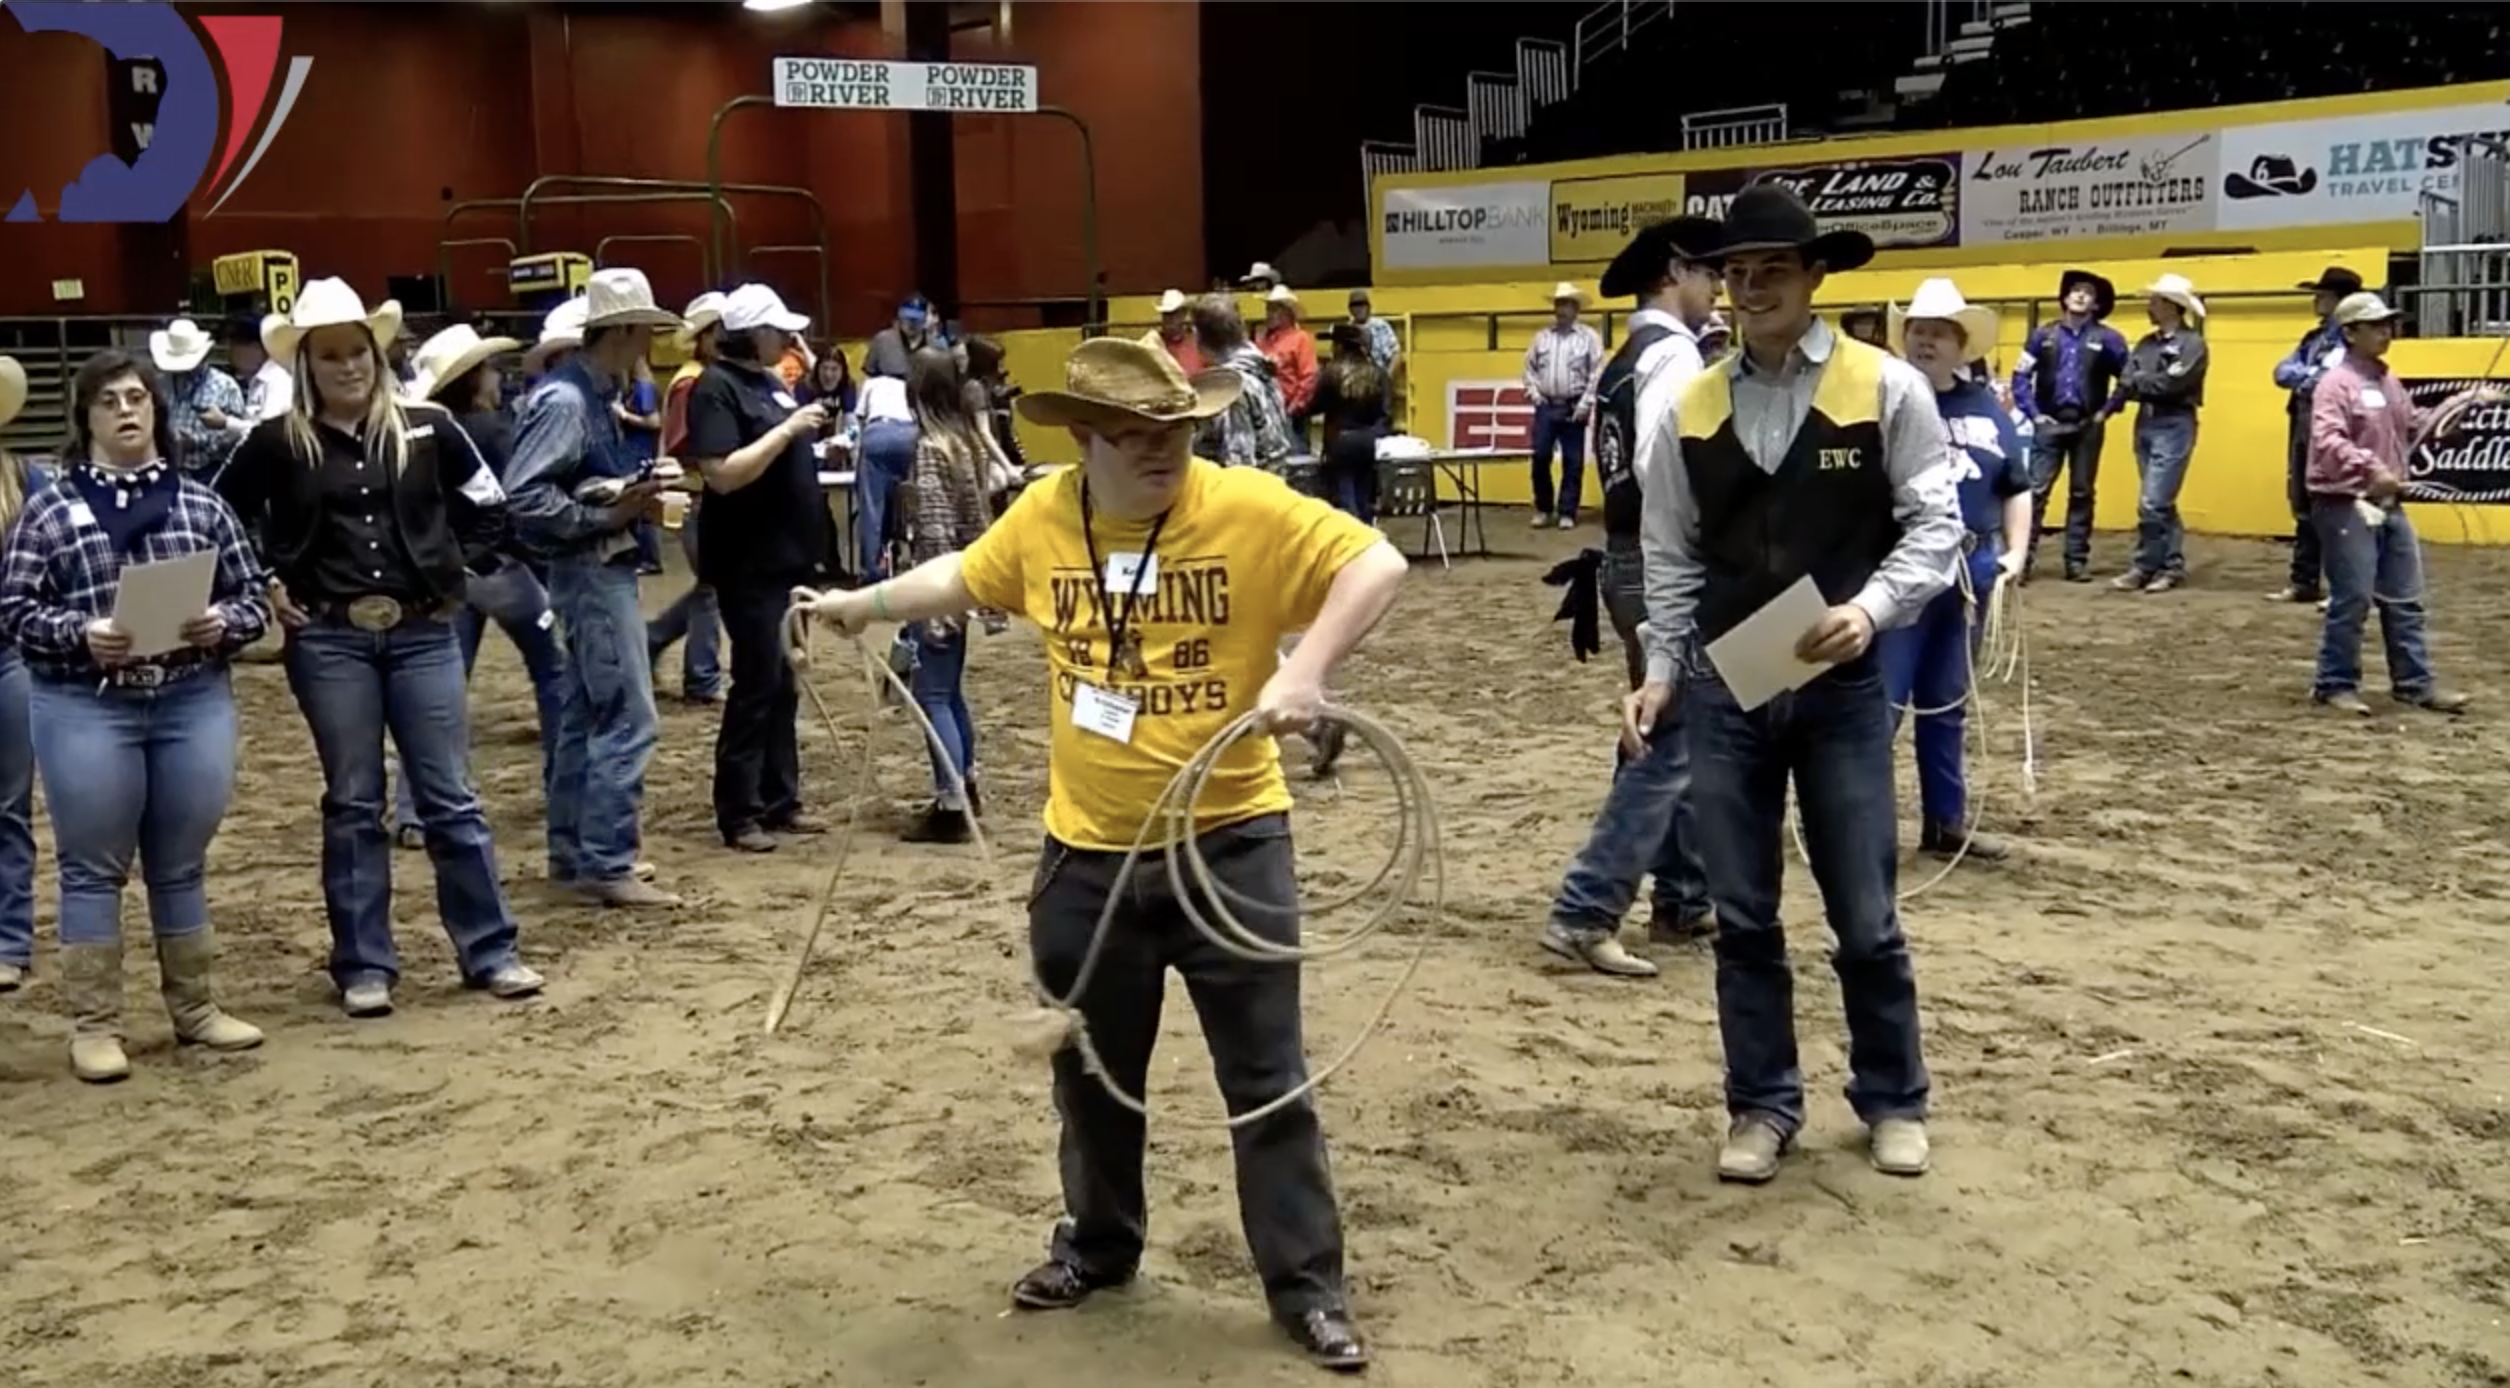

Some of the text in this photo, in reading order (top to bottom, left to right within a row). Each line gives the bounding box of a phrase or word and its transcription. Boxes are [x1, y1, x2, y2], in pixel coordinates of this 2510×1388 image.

[132, 66, 157, 93] R
[786, 60, 890, 83] POWDER
[927, 66, 1026, 87] POWDER
[810, 83, 890, 105] RIVER
[949, 88, 1026, 109] RIVER
[1971, 147, 2130, 180] Lou Taubert
[1822, 171, 1909, 196] LAND
[1915, 175, 1937, 189] &
[2019, 176, 2205, 214] RANCH OUTFITTERS
[2328, 178, 2414, 198] TRAVEL
[1809, 194, 1897, 213] LEASING
[1557, 202, 1629, 238] Wyoming
[1819, 448, 1861, 470] EWC
[1174, 638, 1210, 668] 86
[1059, 672, 1227, 715] CBOYS
